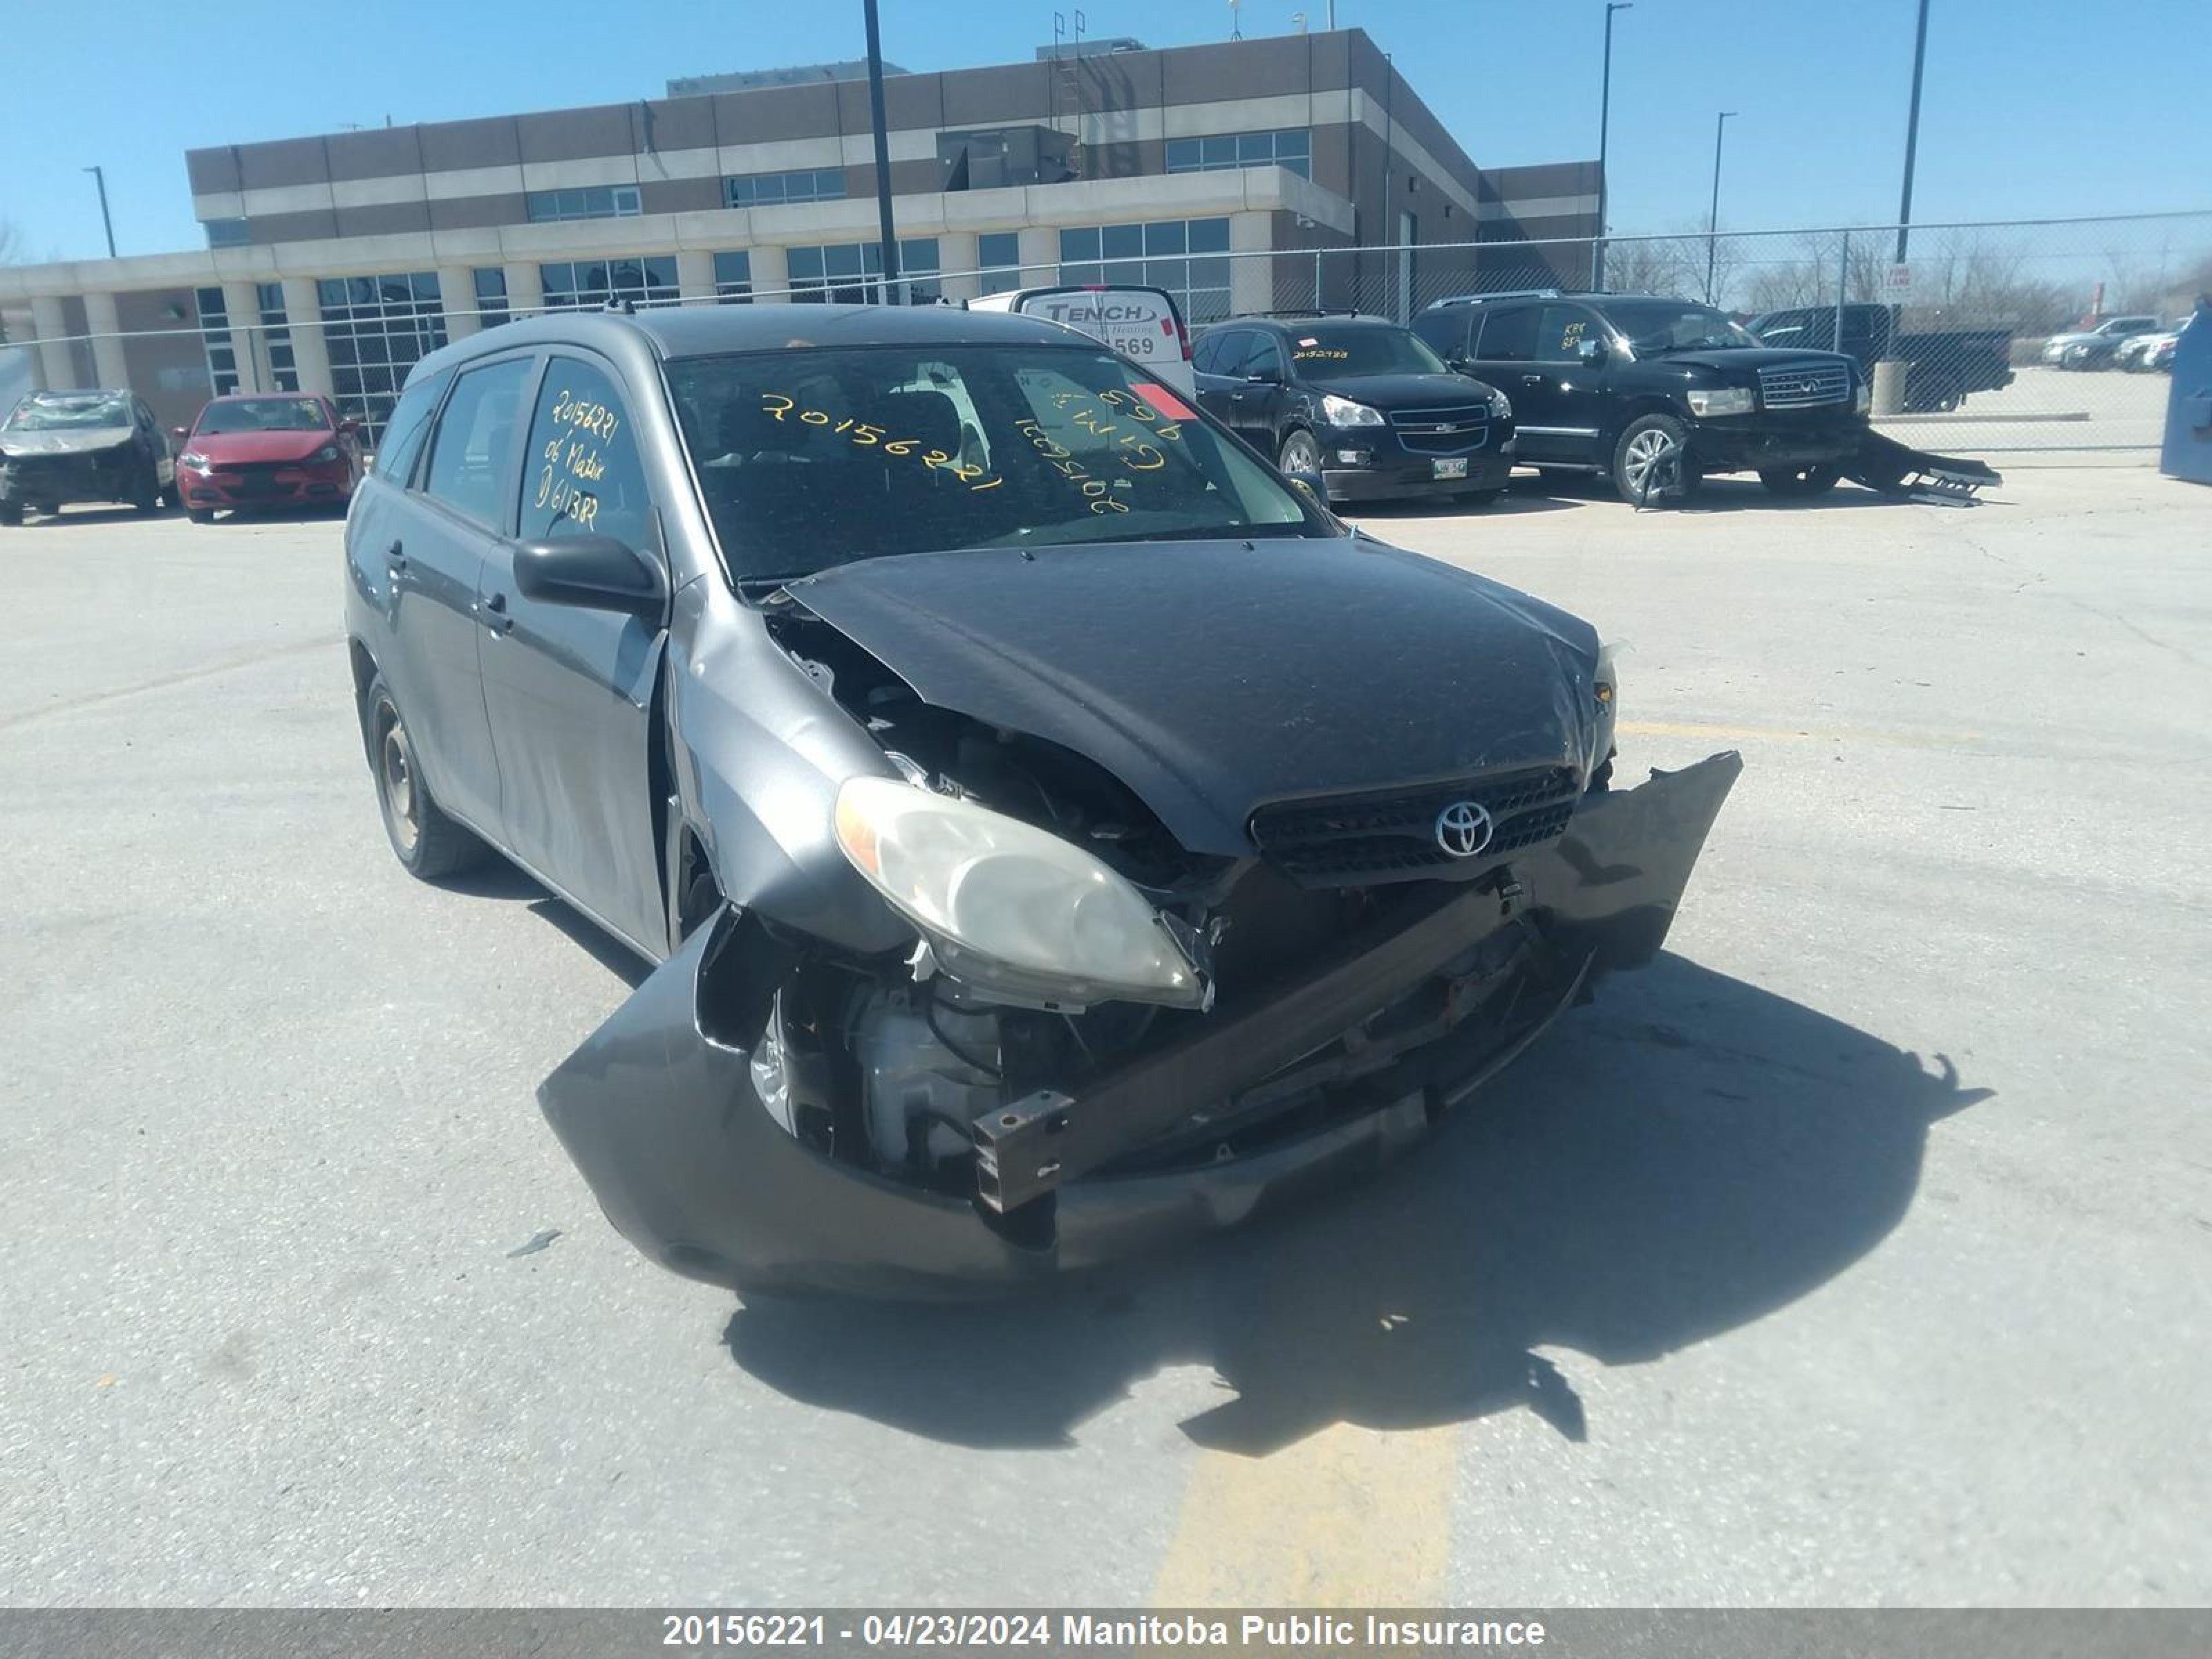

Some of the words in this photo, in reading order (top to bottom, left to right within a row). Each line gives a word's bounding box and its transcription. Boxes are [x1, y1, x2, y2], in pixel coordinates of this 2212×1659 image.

[1047, 303, 1143, 321] TENCH
[1115, 337, 1154, 355] 569
[553, 390, 619, 447] 20156221
[762, 393, 1003, 490] 20156221
